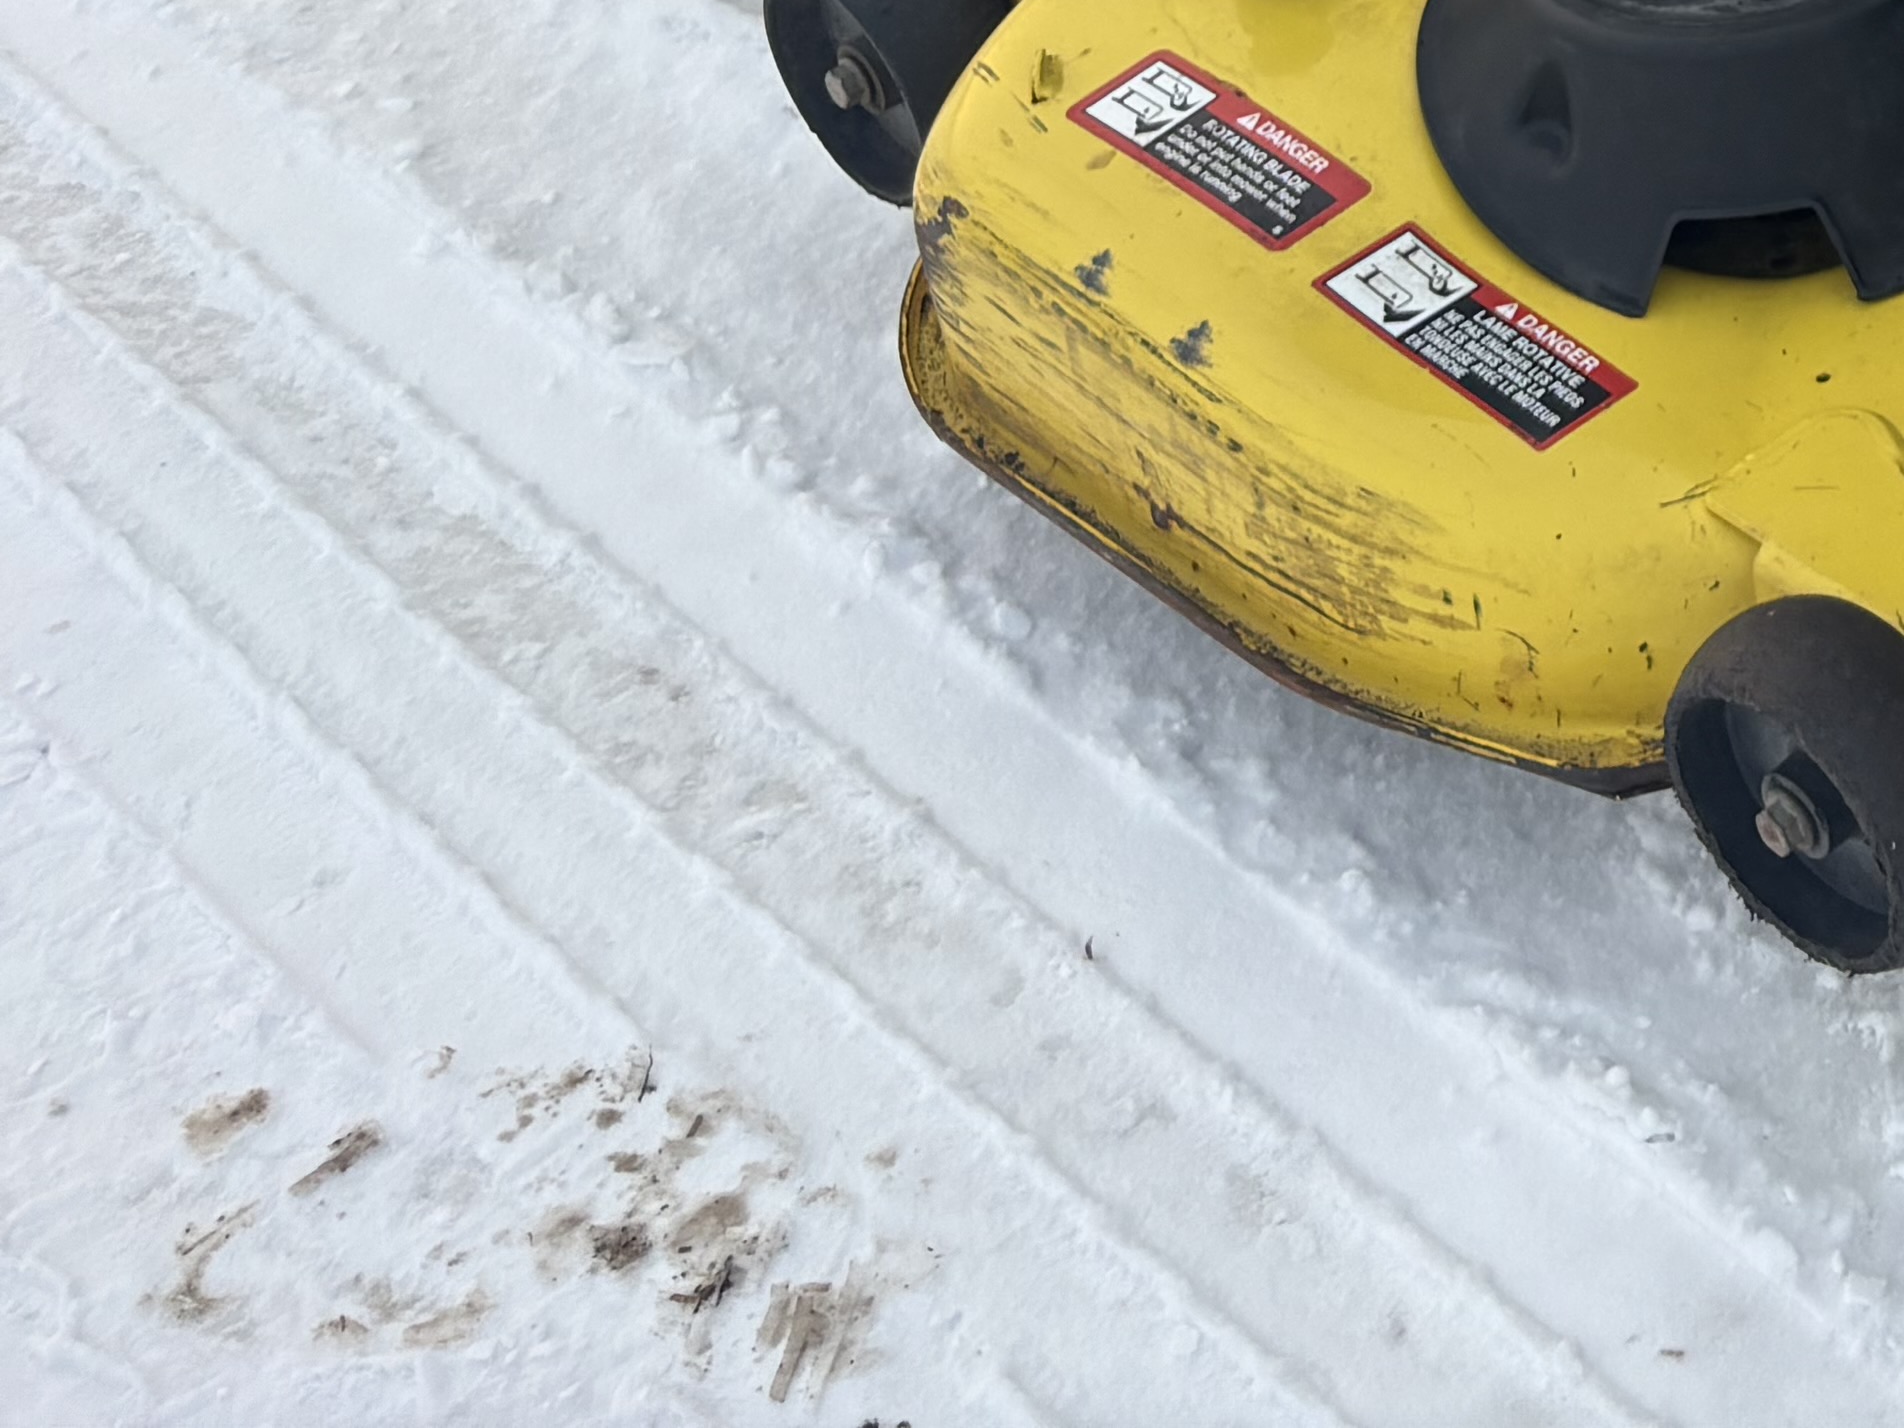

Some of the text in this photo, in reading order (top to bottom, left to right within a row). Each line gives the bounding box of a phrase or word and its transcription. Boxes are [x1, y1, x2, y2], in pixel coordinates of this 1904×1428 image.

[1202, 118, 1312, 194] ROTATING BLADE
[1255, 120, 1330, 174] DANGER
[1444, 326, 1469, 345] LES
[1463, 340, 1503, 368] MAINS
[1498, 363, 1532, 388] DANS
[1526, 383, 1546, 399] LA
[1459, 319, 1486, 339] PAS
[1528, 365, 1553, 386] LES
[1548, 380, 1585, 409] PIEDS
[1472, 309, 1586, 390] LAME ROTATIVE
[1516, 314, 1601, 374] DANGER
[1470, 362, 1503, 386] AVEC
[1498, 380, 1519, 396] LE
[1511, 390, 1562, 428] MOTEUR
